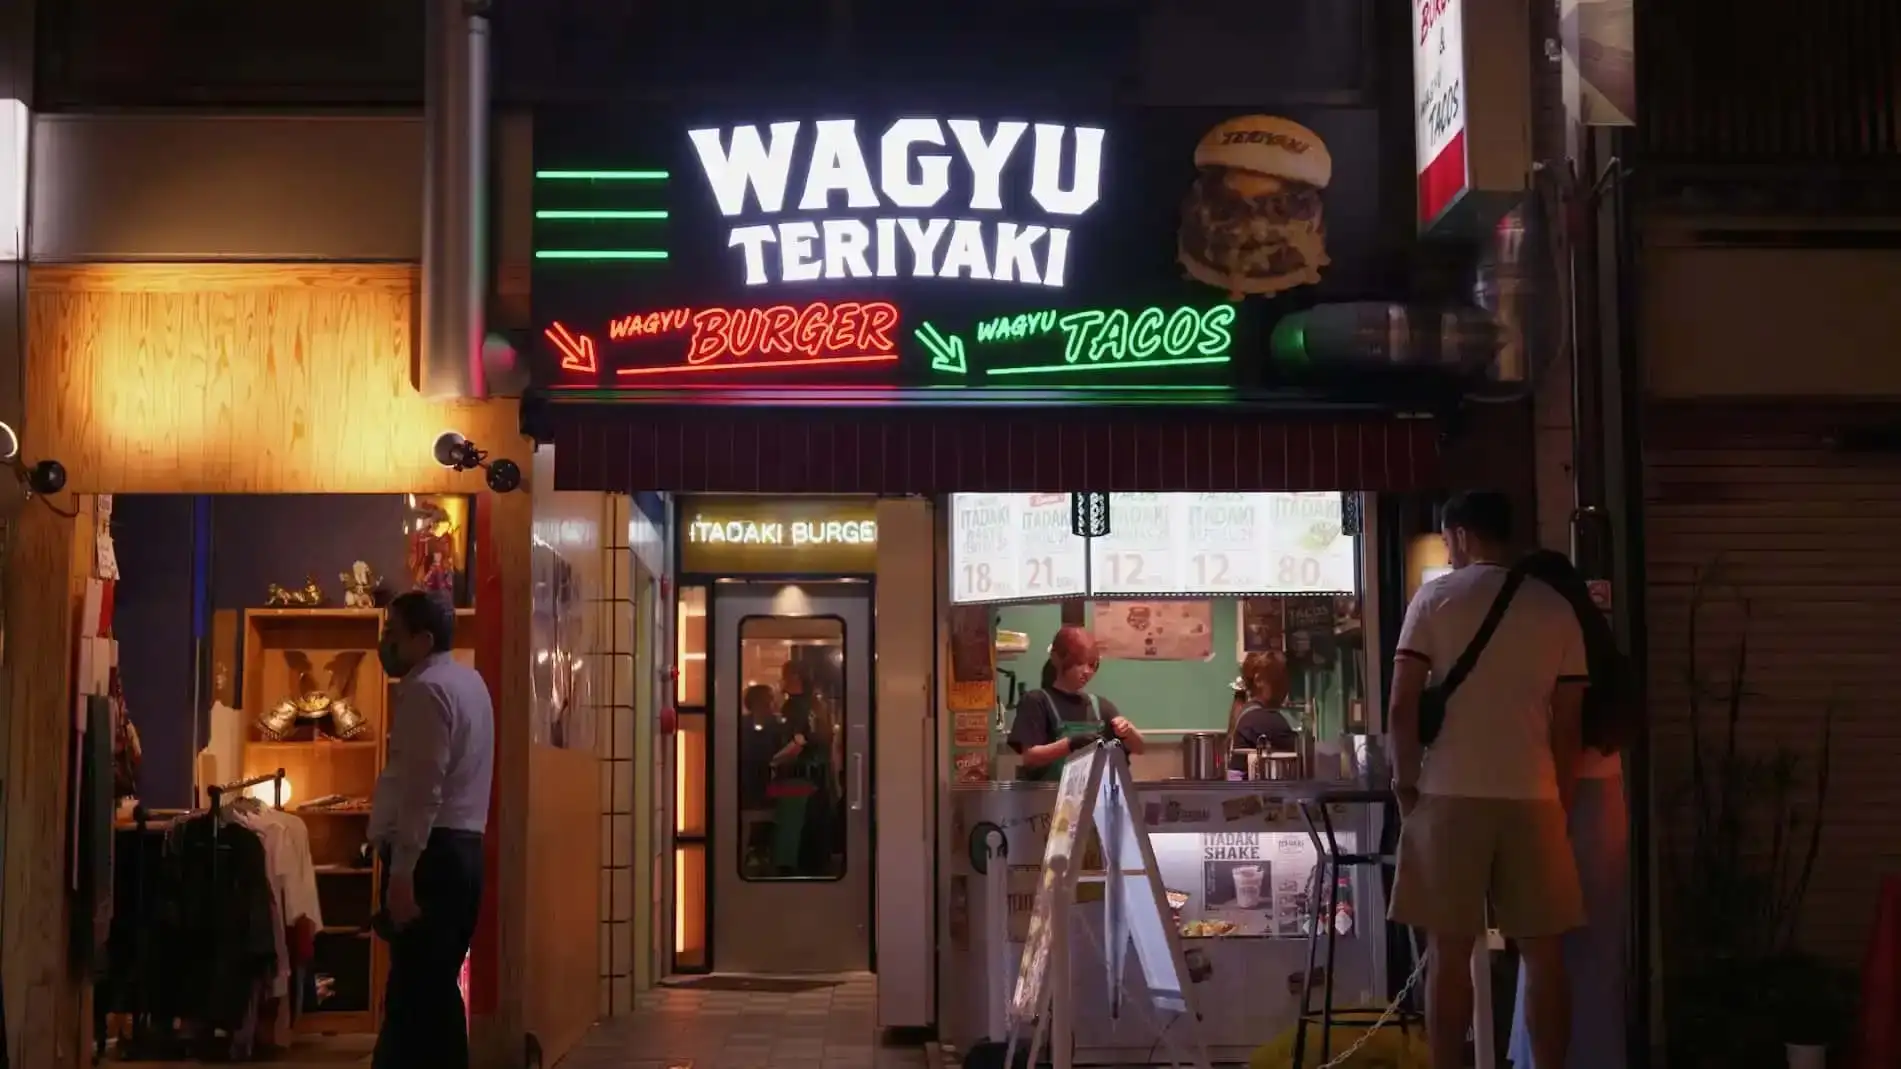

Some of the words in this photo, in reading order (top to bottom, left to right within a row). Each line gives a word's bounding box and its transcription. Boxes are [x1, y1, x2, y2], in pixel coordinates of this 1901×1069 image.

[1428, 80, 1459, 146] TACOS
[687, 117, 1106, 217] WAGYU
[728, 217, 1072, 287] TERIYAKI
[609, 307, 690, 340] WAGYU
[686, 301, 900, 365] BURGER
[976, 309, 1057, 342] WAGYU
[1059, 303, 1236, 362] TACOS
[690, 519, 783, 544] ITADAKI
[791, 519, 878, 545] BURGE
[1022, 509, 1071, 530] ITADAK
[1110, 504, 1169, 526] TADAKI
[1203, 846, 1261, 860] SHAKE
